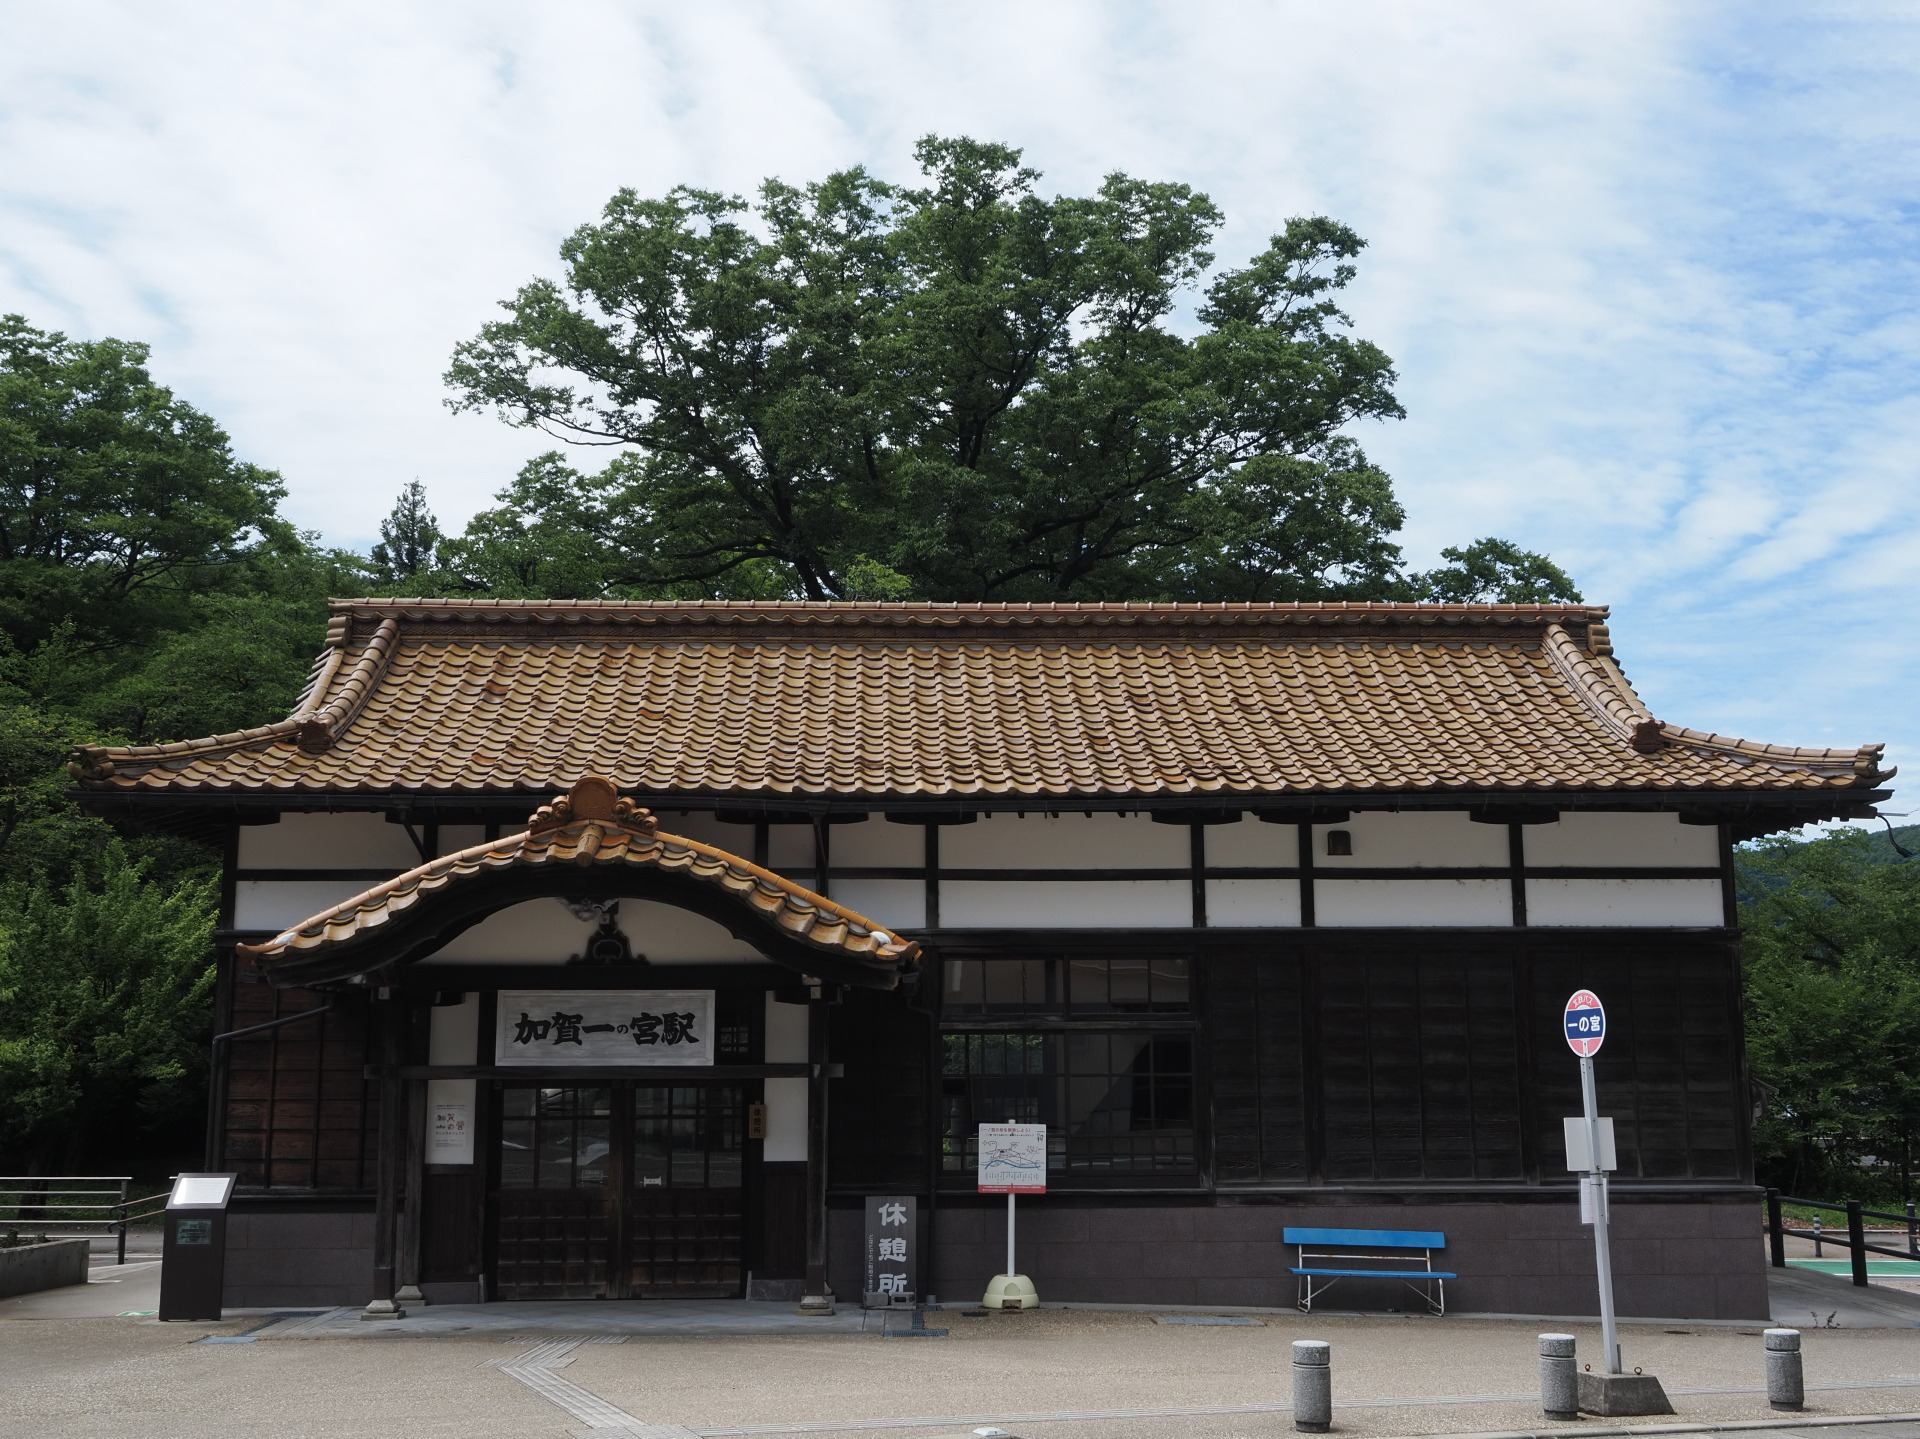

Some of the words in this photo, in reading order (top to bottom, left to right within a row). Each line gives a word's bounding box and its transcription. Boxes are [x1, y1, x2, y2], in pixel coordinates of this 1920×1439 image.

[513, 1012, 699, 1045] 加賀一の宮駅
[1567, 1015, 1600, 1032] 一の宮
[878, 1202, 907, 1296] 休憩所
